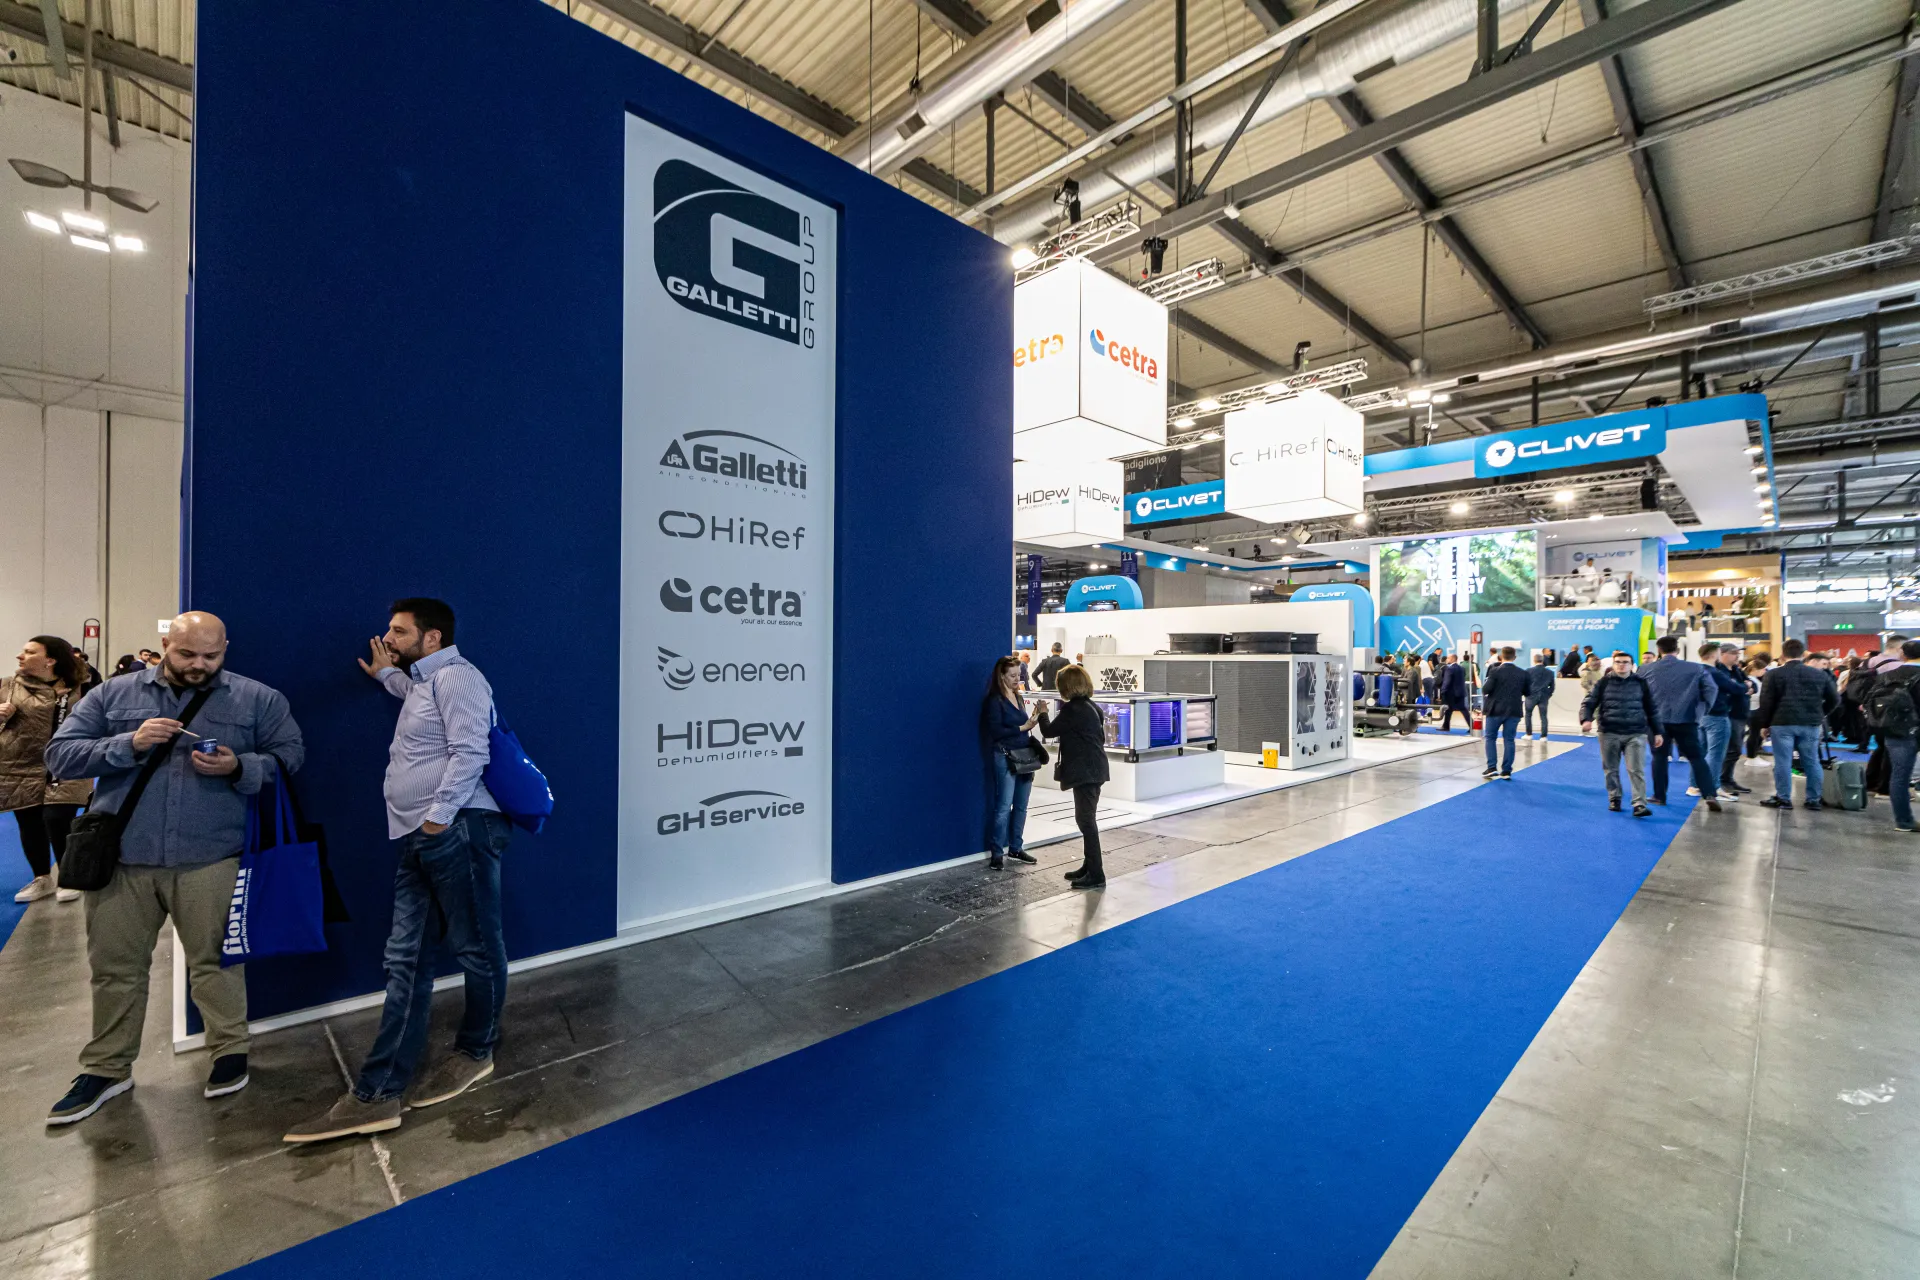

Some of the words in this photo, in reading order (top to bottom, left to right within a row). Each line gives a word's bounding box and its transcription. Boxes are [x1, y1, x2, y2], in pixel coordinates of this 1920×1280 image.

[803, 215, 815, 350] GROUP
[666, 275, 797, 334] GALLETTI
[1108, 340, 1158, 379] cetra
[1257, 437, 1319, 462] HiRef
[1338, 443, 1362, 466] HiRef
[693, 444, 807, 490] Galletti
[1125, 455, 1167, 470] adiglione
[689, 475, 806, 499] CONDITIONING
[1017, 487, 1070, 505] HiDew
[1079, 485, 1120, 505] HiDew
[711, 515, 806, 550] HiRef
[1028, 560, 1035, 571] 9
[700, 582, 802, 618] cetra
[702, 662, 806, 683] eneren
[657, 718, 805, 753] HiDew
[657, 748, 778, 767] Dehumidifiers
[657, 809, 705, 835] GH
[710, 801, 805, 827] Service
